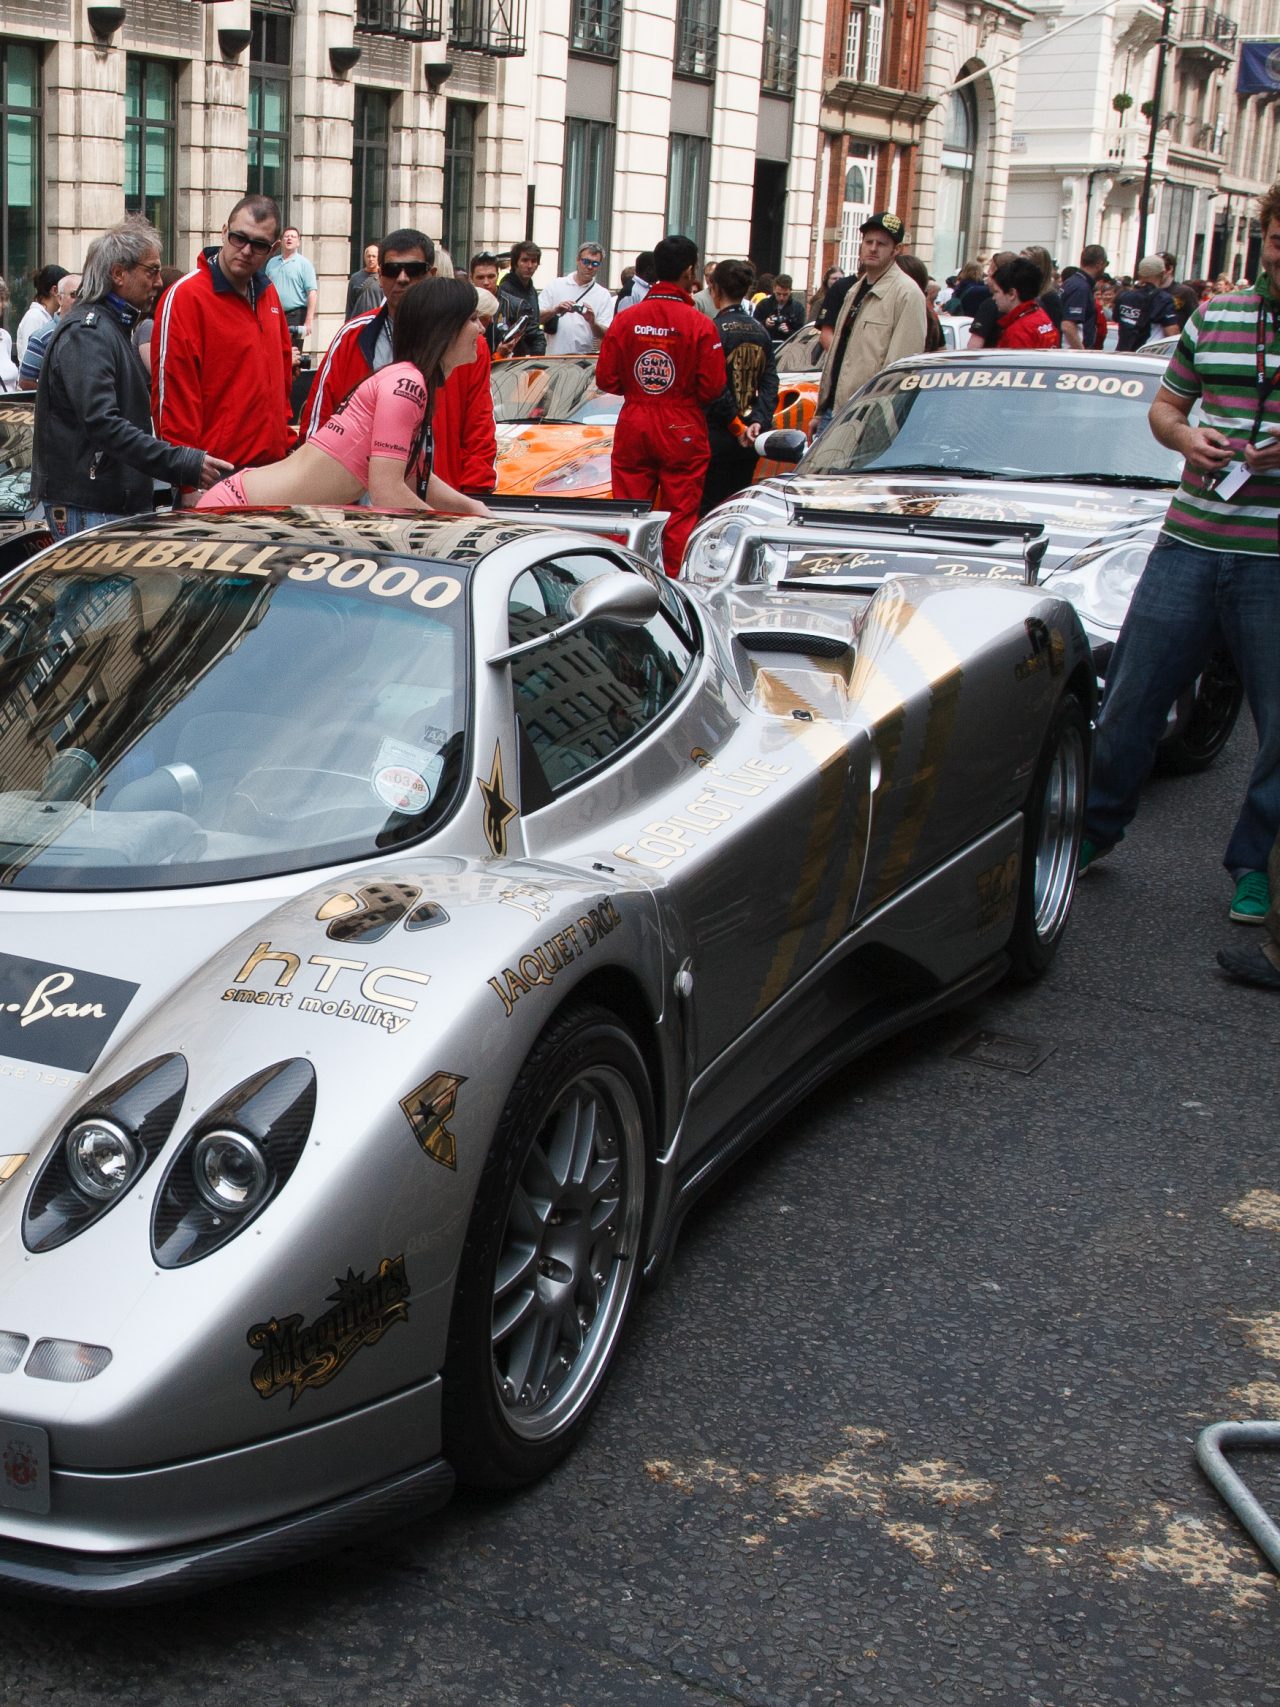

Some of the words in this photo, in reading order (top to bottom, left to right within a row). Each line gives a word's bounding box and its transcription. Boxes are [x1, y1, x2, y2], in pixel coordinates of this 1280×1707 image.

[899, 371, 1048, 391] GUMBALL
[1055, 373, 1144, 397] 3000
[23, 541, 284, 577] GUMBALL
[287, 551, 462, 609] 3000
[486, 924, 585, 1018] JAQUET
[220, 987, 294, 1009] smart
[297, 997, 412, 1034] mobility
